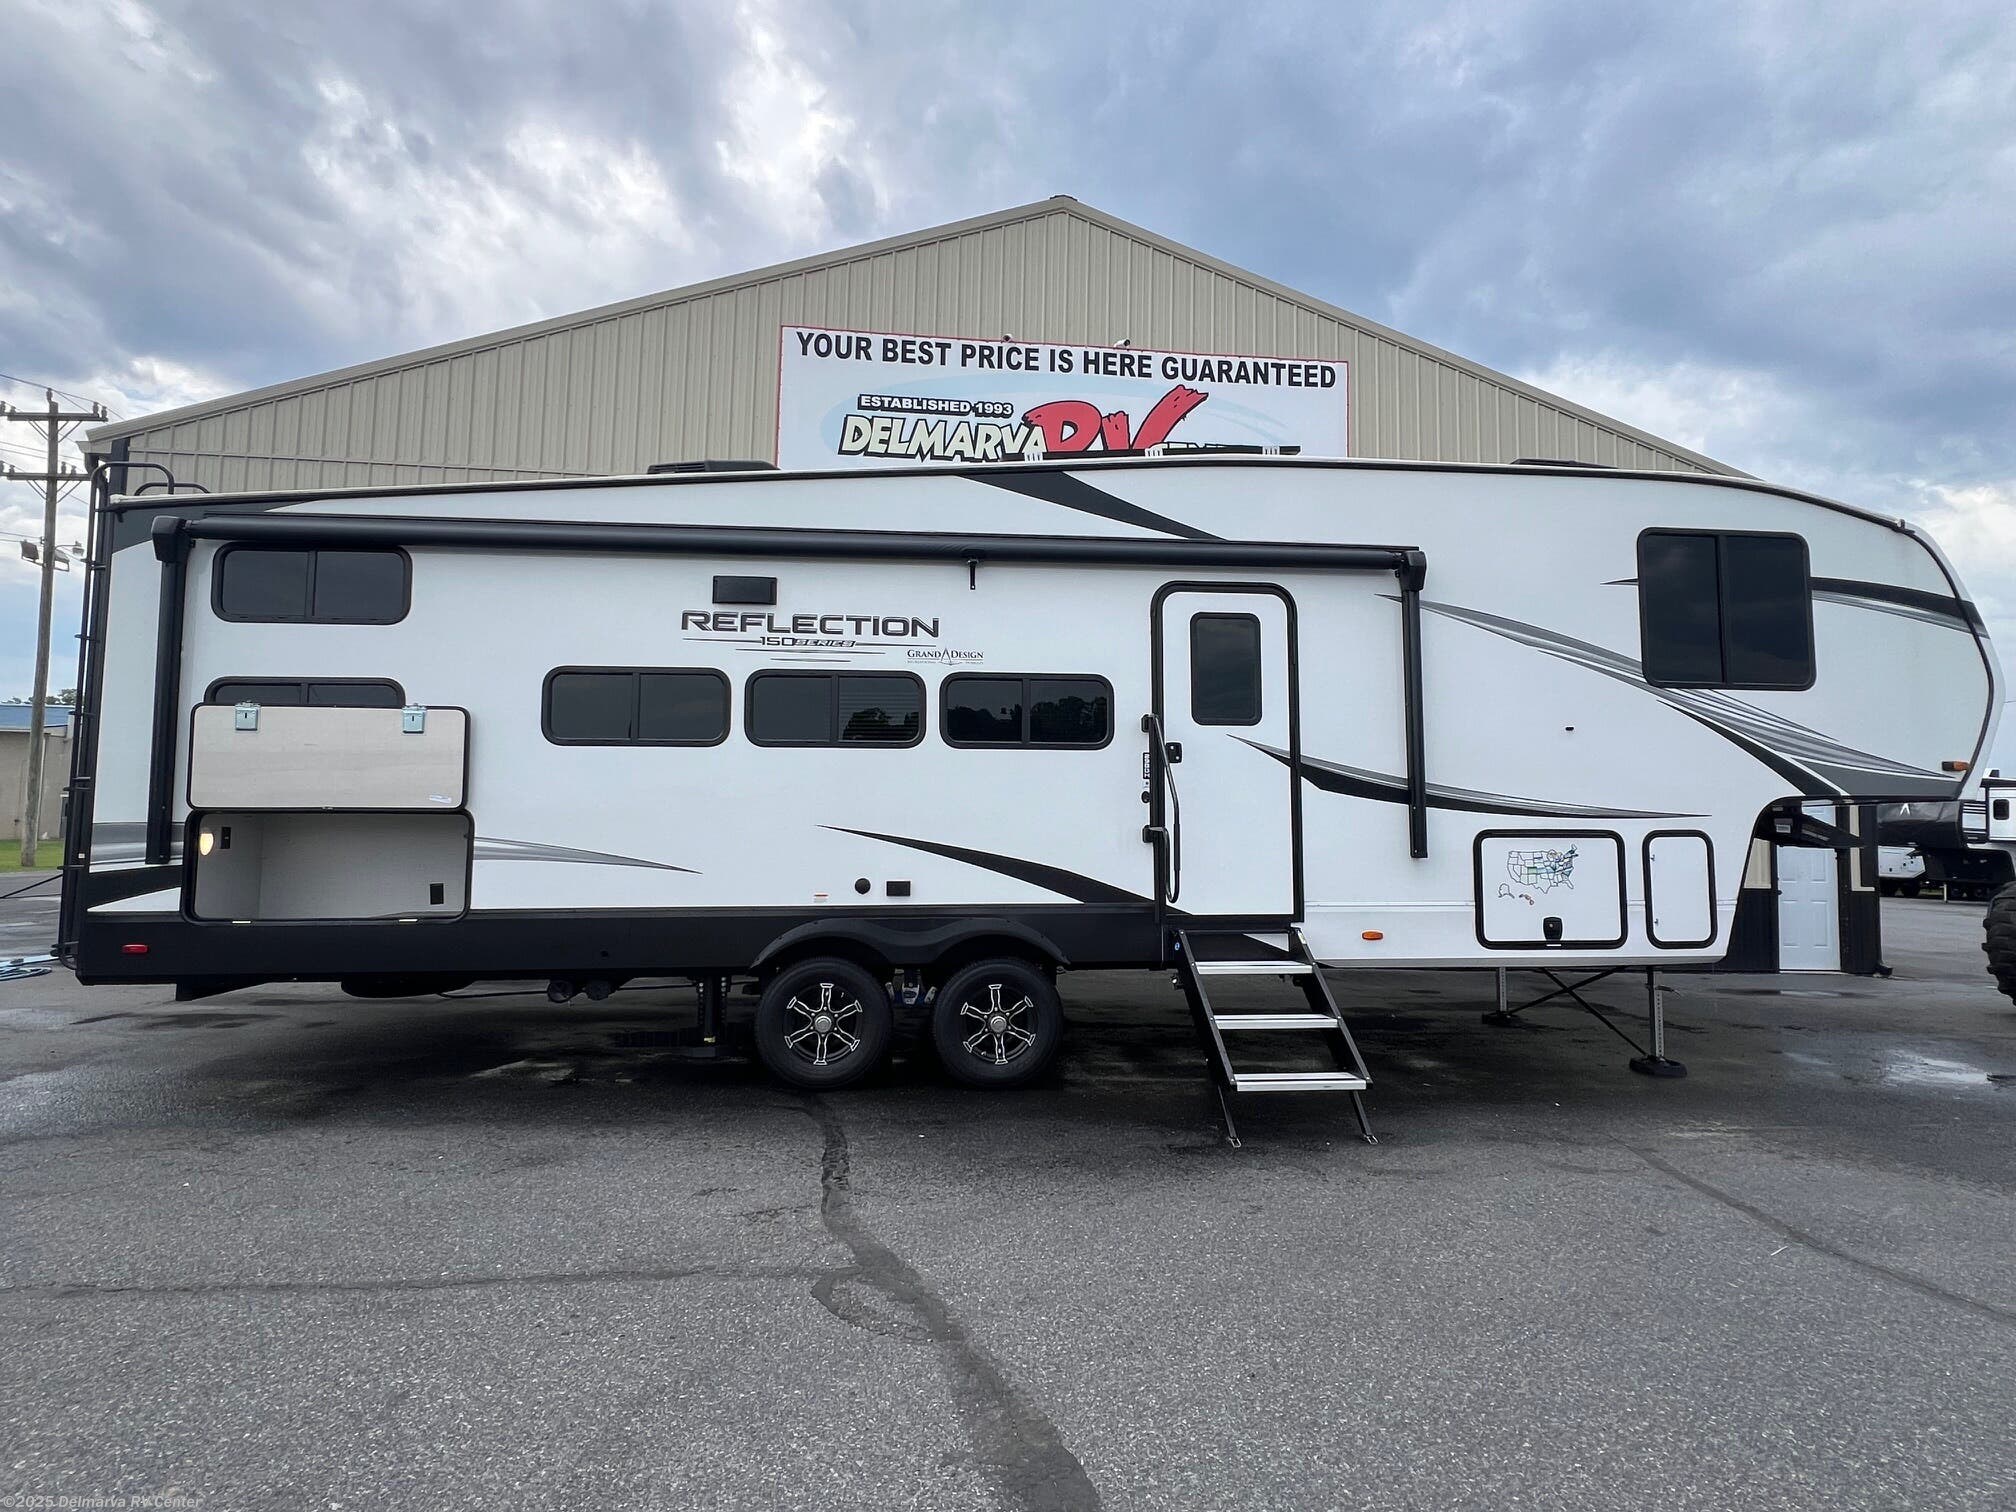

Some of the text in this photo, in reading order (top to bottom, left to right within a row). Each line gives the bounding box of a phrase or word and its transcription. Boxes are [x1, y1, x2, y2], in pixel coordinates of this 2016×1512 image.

[796, 331, 1336, 388] YOUR BEST PRICE IS HERE GUARANTEED
[860, 395, 1013, 416] ESTABLISHED 1993
[838, 414, 1048, 462] DELMARVA
[681, 610, 939, 638] REFLECTION
[907, 649, 984, 659] GRAND DESIGN
